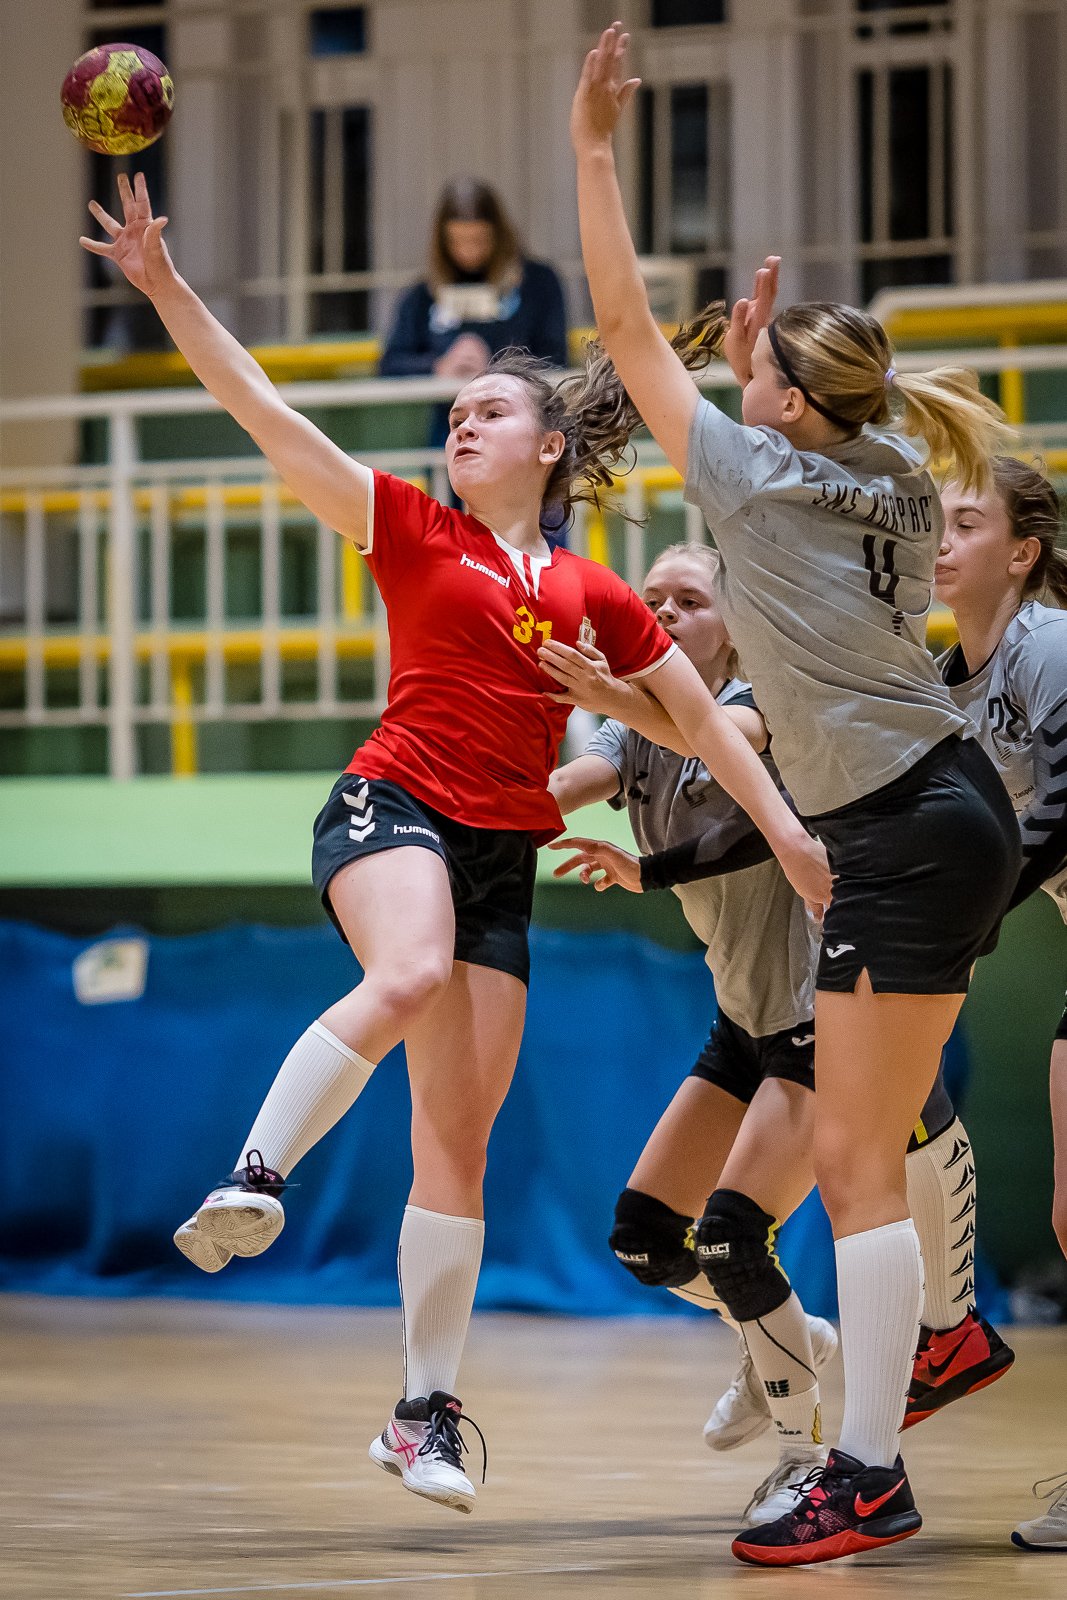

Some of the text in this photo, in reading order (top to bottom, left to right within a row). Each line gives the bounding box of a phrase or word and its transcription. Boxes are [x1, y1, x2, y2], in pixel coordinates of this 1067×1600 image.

[812, 483, 861, 514] SMS
[460, 553, 511, 588] hummel
[393, 824, 440, 844] hummel
[697, 1242, 730, 1255] SELECT
